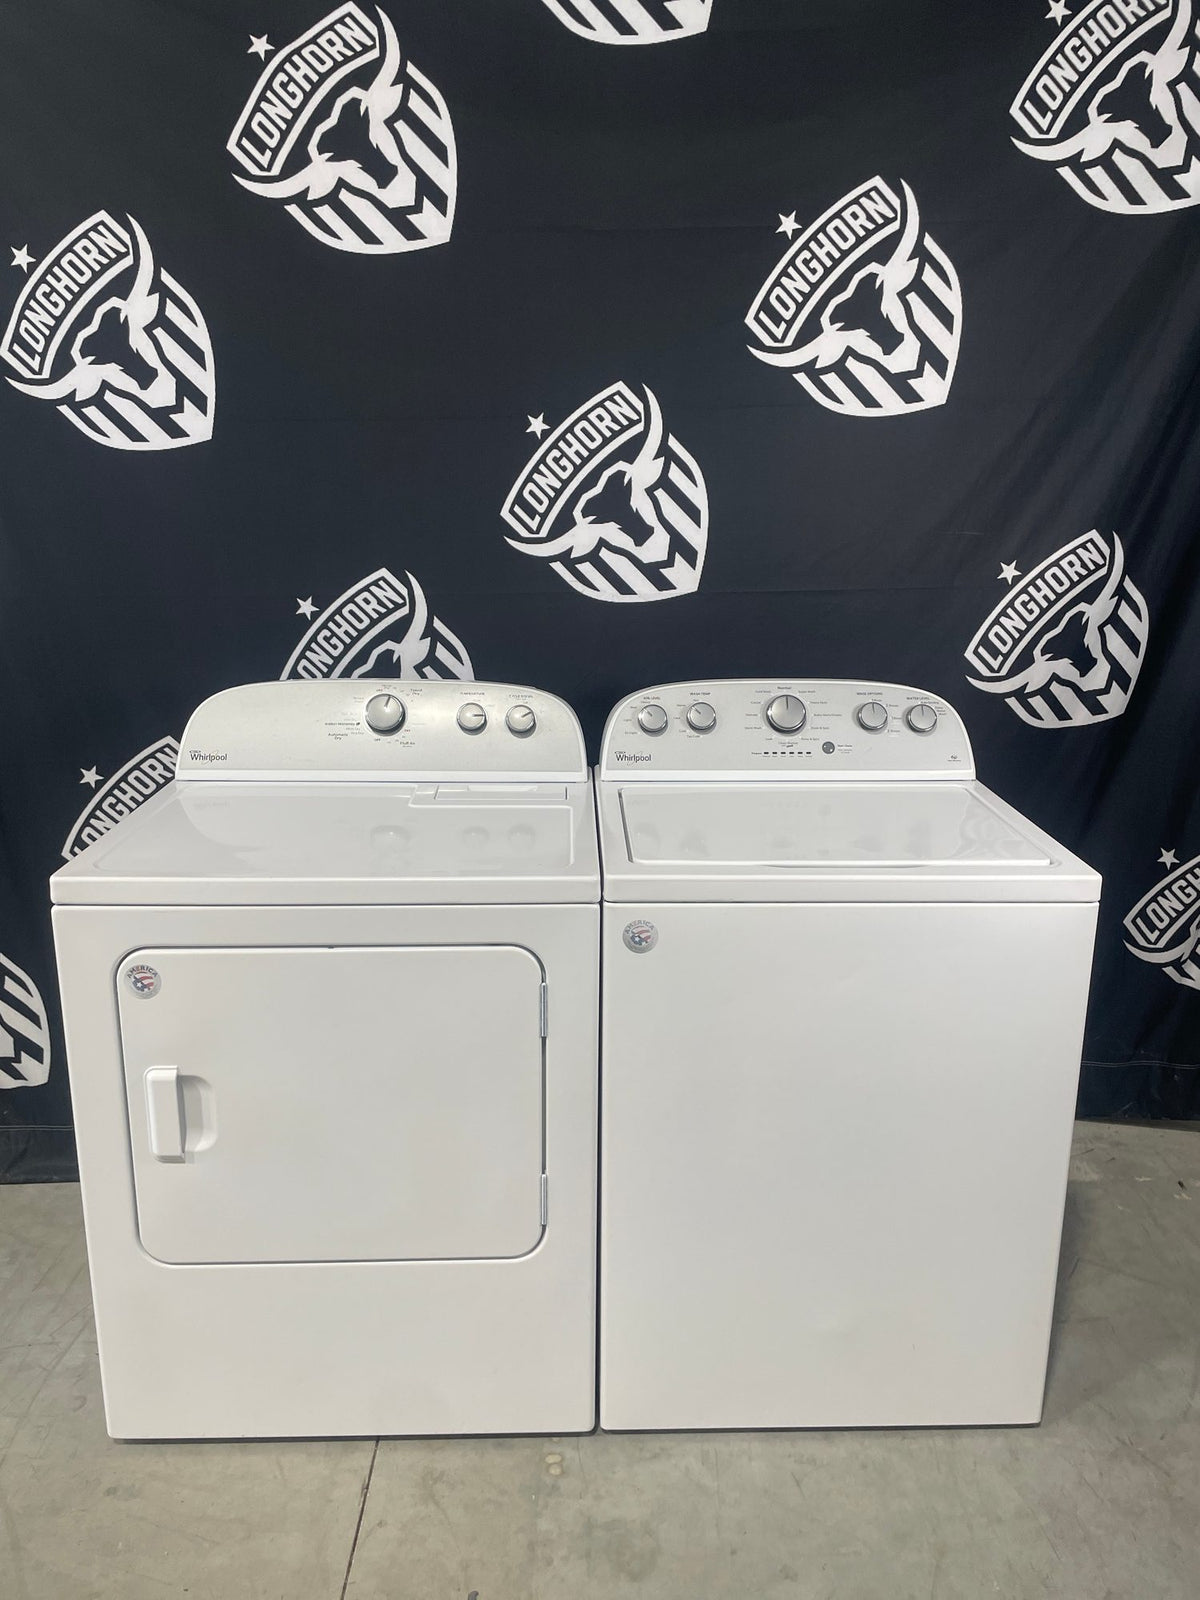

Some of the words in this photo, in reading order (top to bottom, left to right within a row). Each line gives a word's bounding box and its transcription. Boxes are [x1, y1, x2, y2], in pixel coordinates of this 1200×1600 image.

[241, 17, 375, 168] LONGHORN
[13, 225, 128, 372] LONGHORN
[759, 191, 896, 340] LONGHORN
[513, 395, 640, 531] LONGHORN
[296, 580, 405, 679] ONGHORN
[978, 542, 1105, 670] LONGHORN
[70, 747, 178, 859] ONGHORN
[190, 753, 228, 763] Whirlpool
[616, 754, 652, 763] Whirlpool
[127, 965, 158, 979] AMERICA
